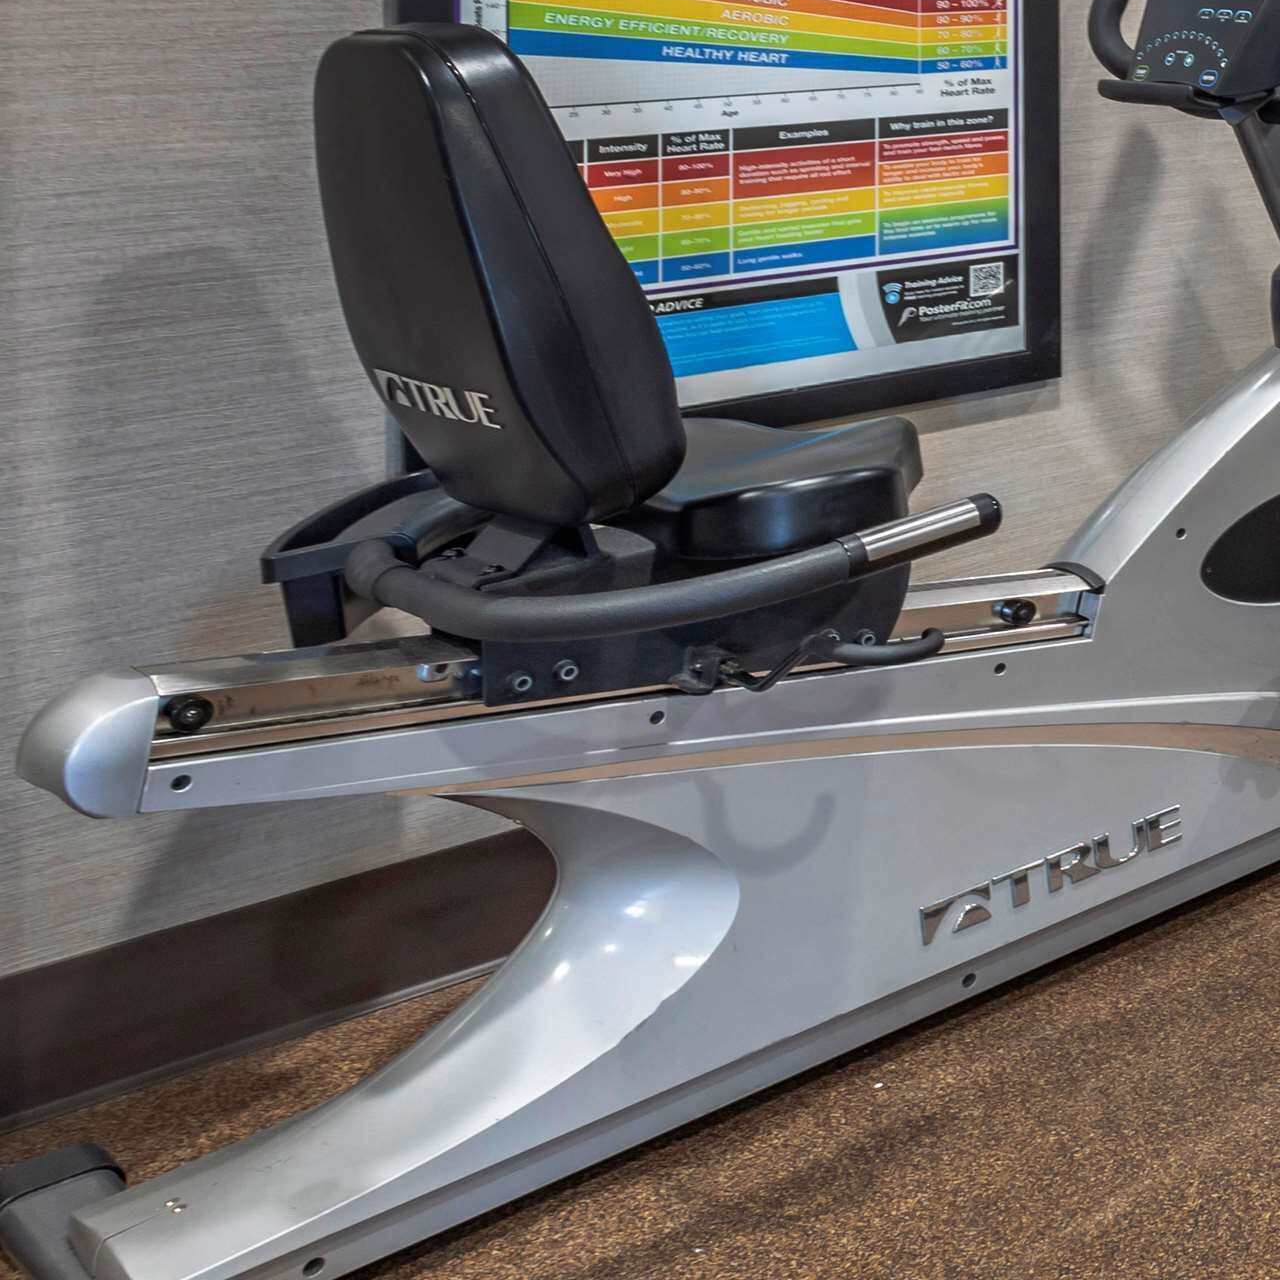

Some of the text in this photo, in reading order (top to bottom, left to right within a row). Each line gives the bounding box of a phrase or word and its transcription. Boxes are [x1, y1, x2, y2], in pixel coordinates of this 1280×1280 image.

[720, 10, 789, 26] AEROBIC
[544, 12, 789, 44] ENERGY EFFICIENT/RECOVERY
[661, 45, 789, 64] HEALTHY HEART
[958, 78, 968, 86] of
[971, 77, 992, 85] Max
[940, 87, 996, 97] Heart Rate
[721, 110, 739, 118] Age
[889, 122, 912, 131] Why
[912, 120, 935, 129] train
[947, 118, 964, 126] this
[965, 115, 994, 125] zone?
[670, 133, 722, 144] % of Max
[778, 129, 829, 139] Examples
[599, 143, 649, 154] Intensity
[666, 142, 725, 153] Heart Rate
[904, 276, 964, 289] Training Advice
[655, 298, 704, 313] ADVICE
[400, 376, 501, 429] TRUE
[991, 804, 1183, 909] TRUE
